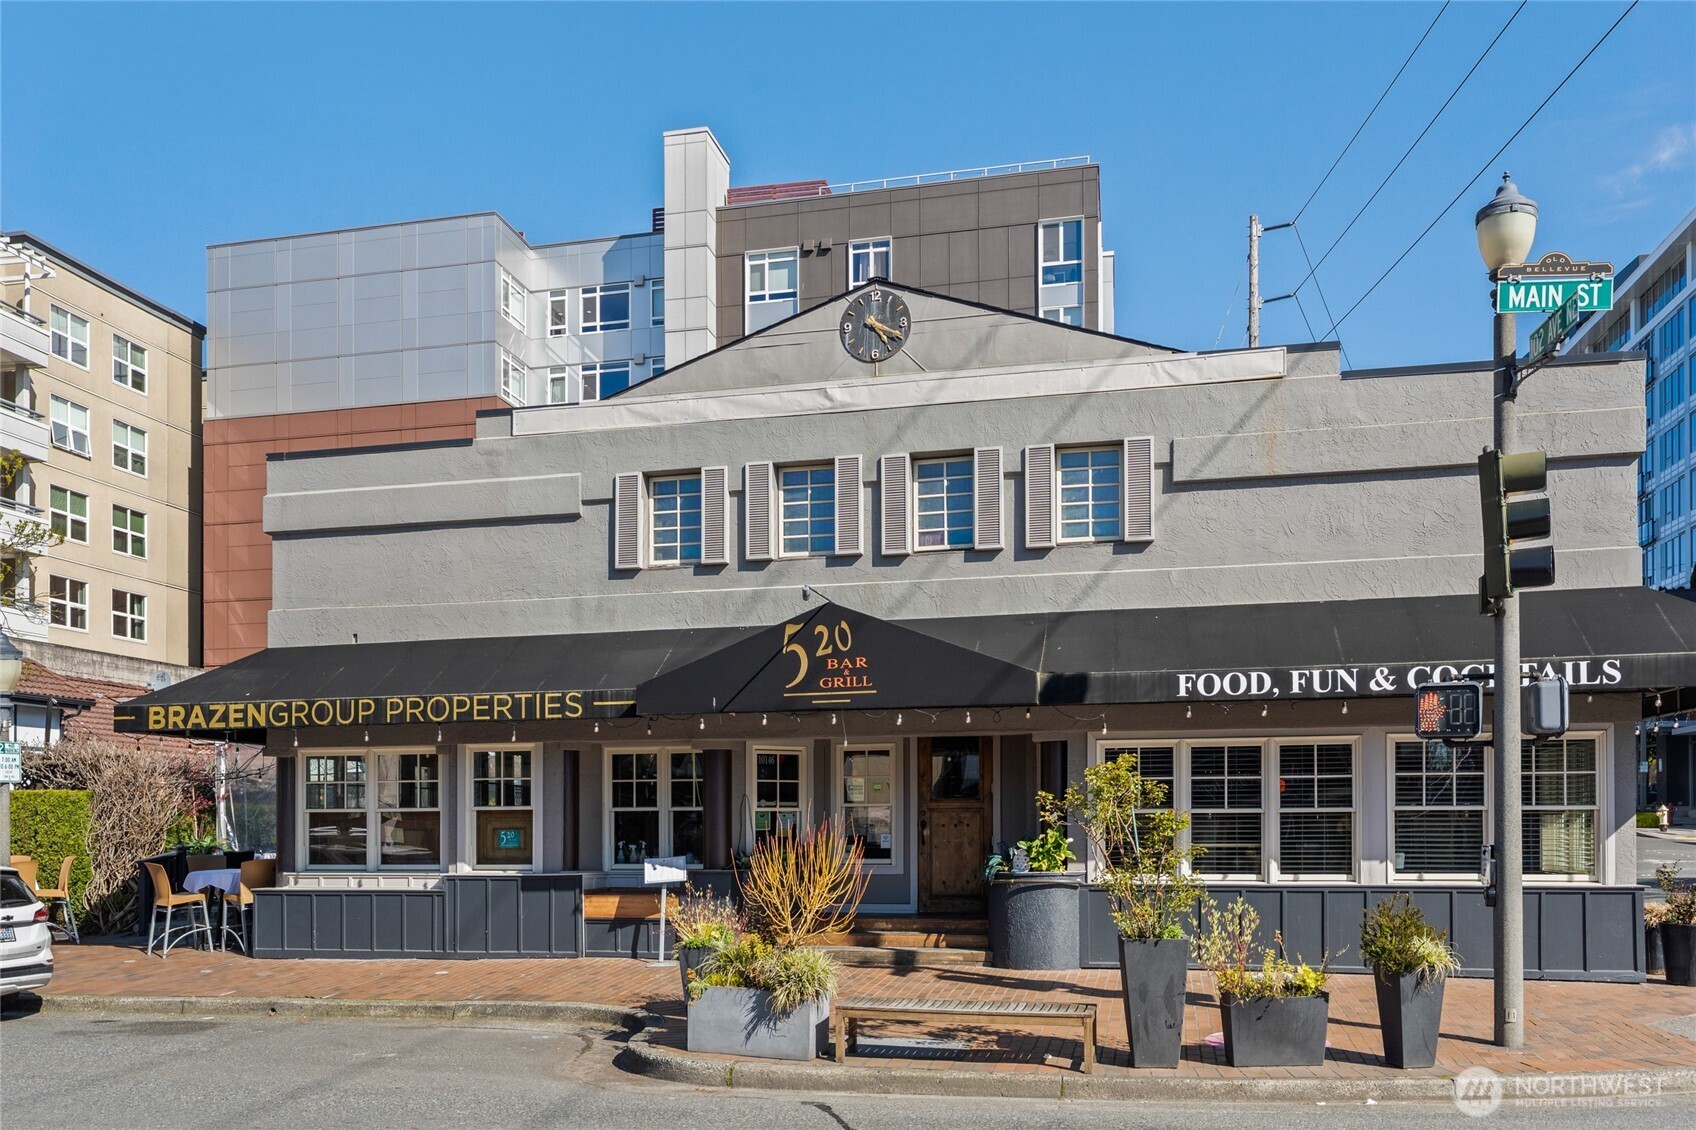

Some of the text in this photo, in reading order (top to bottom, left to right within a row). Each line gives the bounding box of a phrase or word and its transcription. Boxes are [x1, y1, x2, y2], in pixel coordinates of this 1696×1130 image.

[870, 290, 881, 301] 12
[1509, 283, 1602, 308] MAIN ST
[844, 322, 852, 333] 9
[900, 317, 908, 327] 3
[1531, 298, 1577, 359] 102 AVE NE
[871, 349, 879, 359] 6
[783, 620, 852, 689] 520
[826, 656, 868, 670] BAR
[819, 675, 873, 689] GRILL
[1176, 671, 1280, 698] FOOD,
[1289, 667, 1360, 694] FUN
[1369, 666, 1397, 691] &
[387, 691, 583, 723] PROPERTIES
[758, 755, 776, 765] 10146
